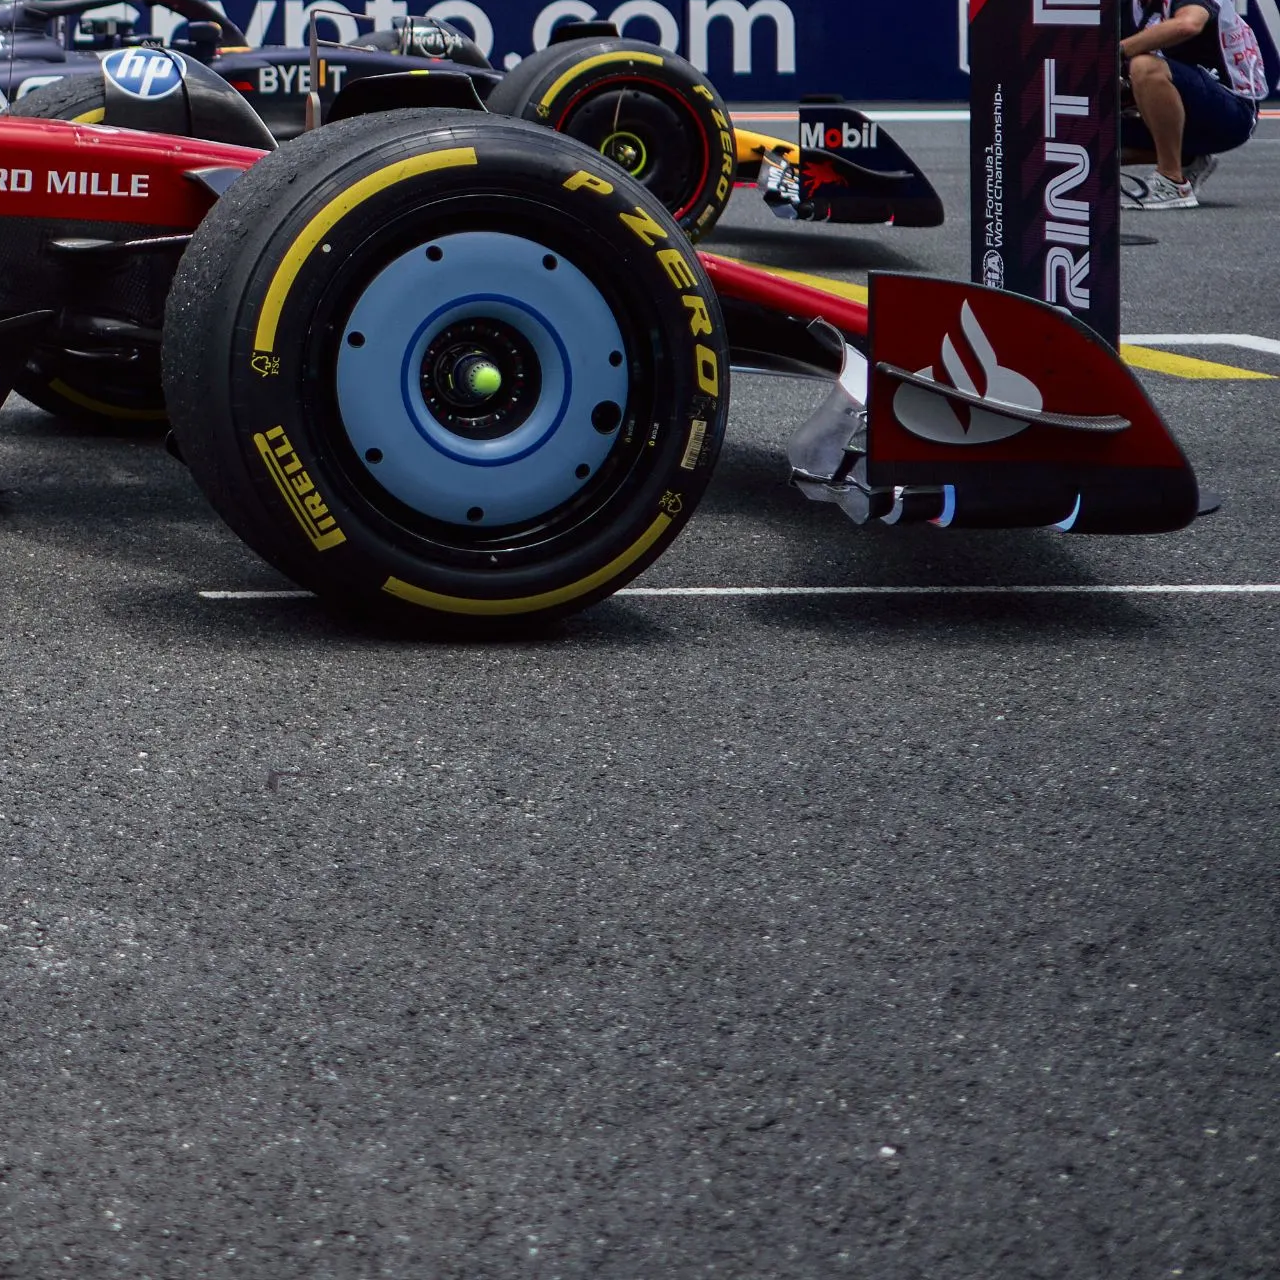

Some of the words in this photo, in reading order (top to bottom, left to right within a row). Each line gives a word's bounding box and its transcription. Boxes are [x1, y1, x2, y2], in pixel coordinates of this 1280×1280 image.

[116, 48, 175, 99] hp
[692, 85, 713, 101] P
[710, 108, 734, 203] ZERO
[801, 122, 877, 150] Mobil
[47, 170, 149, 198] MILLE
[985, 156, 994, 219] Formula
[1045, 59, 1090, 317] RINT
[986, 222, 994, 247] FIA
[994, 202, 1004, 248] World
[562, 170, 614, 196] P
[618, 206, 719, 398] ZERO
[271, 356, 280, 375] FSC
[253, 425, 347, 552] PIRELLI
